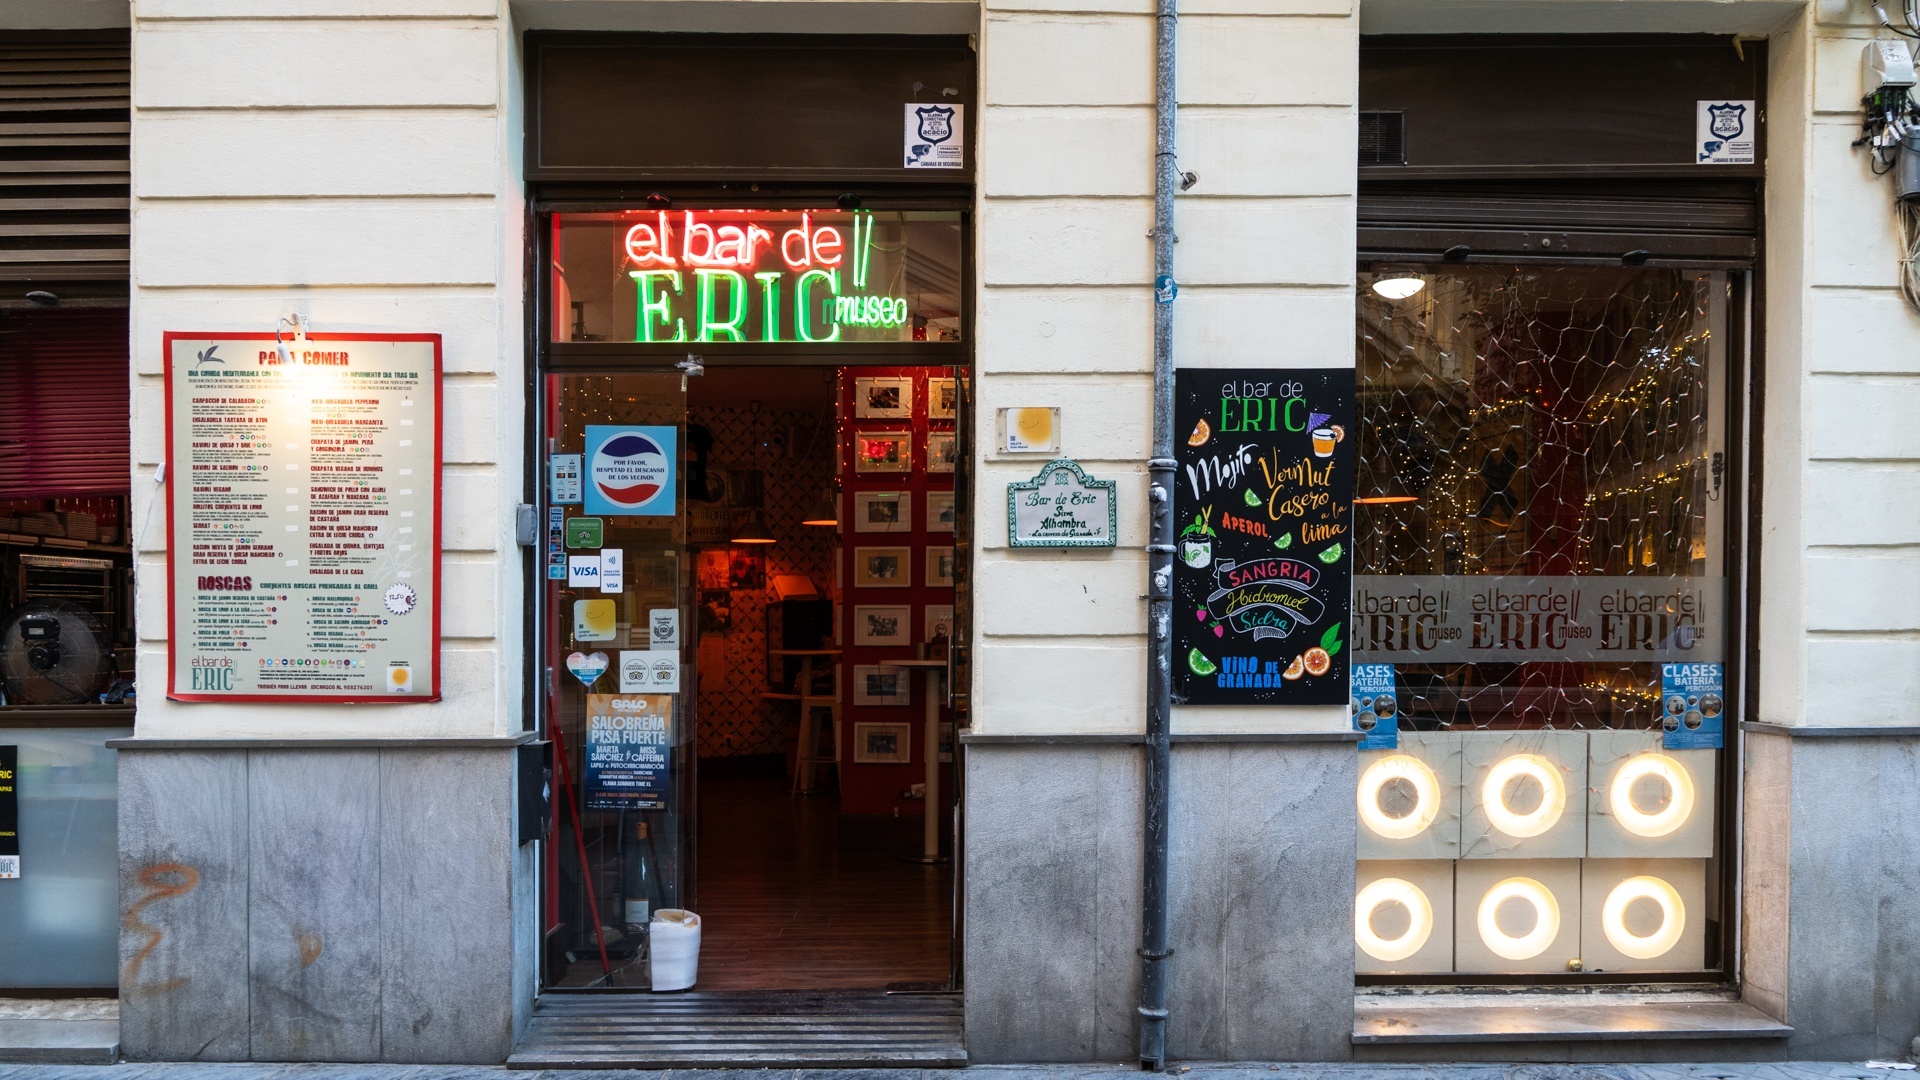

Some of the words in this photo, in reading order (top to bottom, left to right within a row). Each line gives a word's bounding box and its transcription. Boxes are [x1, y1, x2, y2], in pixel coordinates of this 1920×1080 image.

[625, 210, 675, 266] el
[682, 210, 773, 266] bar
[782, 211, 845, 267] de
[628, 268, 842, 342] ERIC
[835, 294, 908, 327] museo
[259, 351, 296, 365] PAA
[303, 351, 349, 366] COMER
[1222, 380, 1240, 398] el
[1243, 380, 1273, 398] bar
[1280, 380, 1303, 398] de
[1219, 398, 1307, 432] ERIC
[1186, 443, 1259, 500] Mojito
[1025, 491, 1051, 506] Bar
[1056, 492, 1067, 505] de
[1071, 492, 1096, 506] Eric
[1268, 484, 1329, 521] Casero
[1054, 506, 1073, 517] Sirve
[1332, 502, 1347, 519] la
[1040, 517, 1086, 529] Alhambra
[1222, 512, 1268, 538] APEROL
[1302, 522, 1347, 545] lima
[572, 566, 598, 576] VISA
[1229, 562, 1310, 587] SANGRIA
[198, 576, 252, 591] ROSCAS
[1226, 585, 1309, 614] Hidromiel
[1241, 611, 1288, 630] Sidra
[1429, 627, 1462, 640] museo
[1468, 613, 1568, 650] ERIC
[1558, 626, 1592, 639] museo
[1596, 613, 1696, 650] ERIC
[1265, 662, 1278, 673] DE
[1352, 665, 1391, 678] ASES
[1663, 664, 1717, 678] CLASES
[191, 668, 233, 690] ERIC
[1217, 674, 1281, 688] GRANADA
[611, 699, 647, 709] SALO
[592, 714, 665, 730] SALOBREÑA
[592, 730, 620, 744] PISA
[623, 730, 665, 744] FUERTE
[631, 754, 664, 762] CAFFEINA
